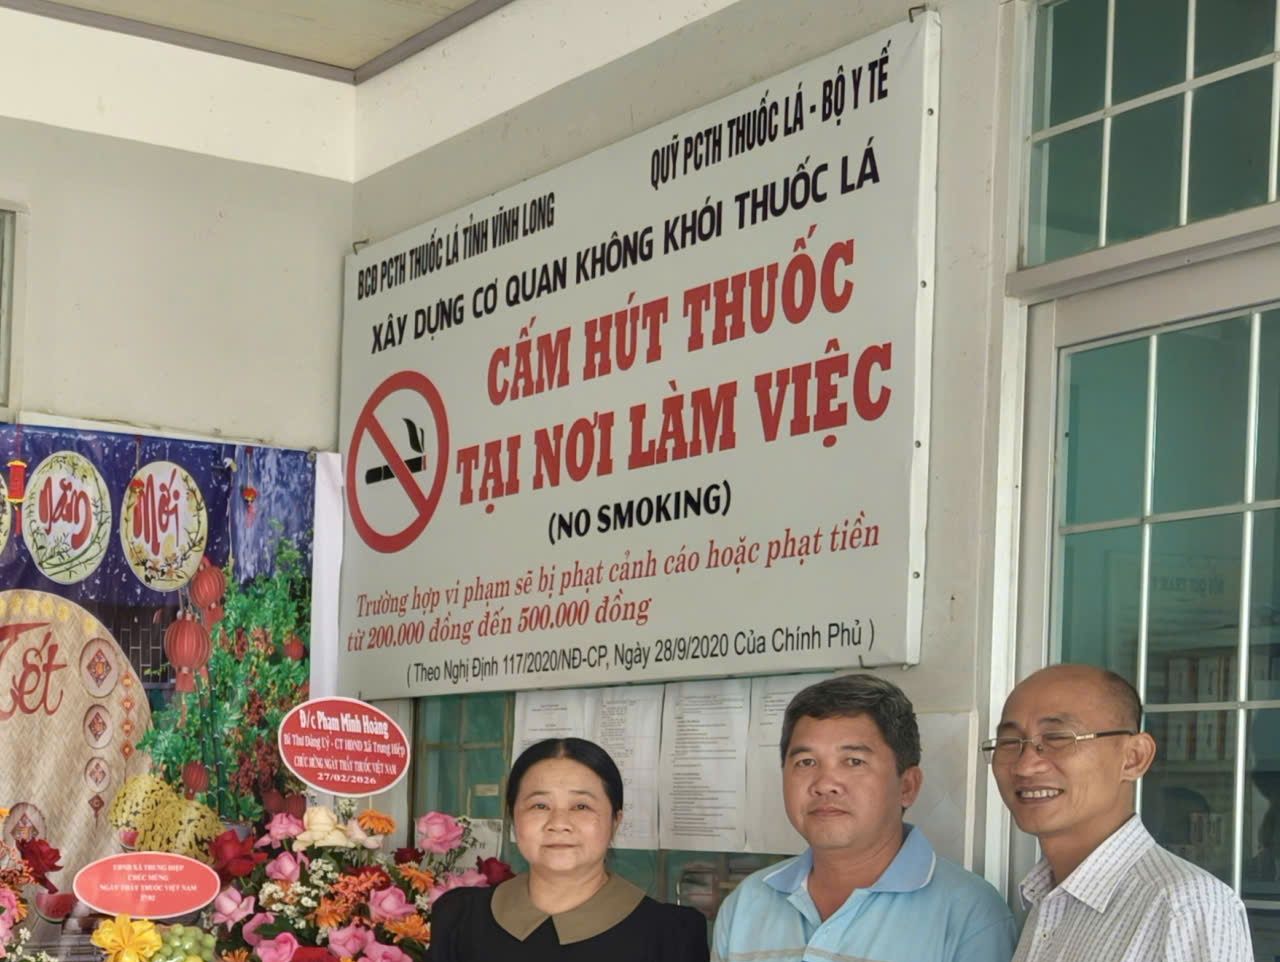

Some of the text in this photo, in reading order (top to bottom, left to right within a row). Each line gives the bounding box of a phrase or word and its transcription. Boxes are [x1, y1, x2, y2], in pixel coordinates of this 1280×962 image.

[651, 40, 891, 190] QUỸ PCTH THUỐC LÁ BỘ Y TẾ
[358, 192, 554, 300] BCĐ PCTH THUỐC LÁ TỈNH VĨNH LONG
[372, 136, 879, 354] XÂY DỰNG CƠ QUAN KHÔNG KHÓI THUỐC LÁ
[488, 224, 854, 404] CẤM HÚT THUỐC
[456, 337, 892, 512] TẠI NƠI LÀM VIỆC
[357, 510, 880, 618] Trường hợp vi phạm sẽ bị phạt cảnh cáo hoặc phạt tiền
[549, 480, 731, 545] (NO SMOKING)
[347, 588, 652, 652] từ 200.000 đồng đến 500.000 đồng
[414, 662, 441, 683] Theo
[444, 659, 469, 685] Nghị
[472, 656, 498, 681] Định
[503, 645, 609, 674] 117/2020/NĐ-CP,
[614, 641, 651, 671] Ngày
[654, 632, 729, 663] 28/9/2020
[733, 629, 766, 656] Của
[771, 624, 821, 652] Chính
[827, 619, 862, 648] Phủ
[299, 709, 316, 728] Đ/c
[317, 711, 340, 734] Phạm
[340, 713, 361, 733] Minh
[317, 772, 377, 785] 27/02/2026
